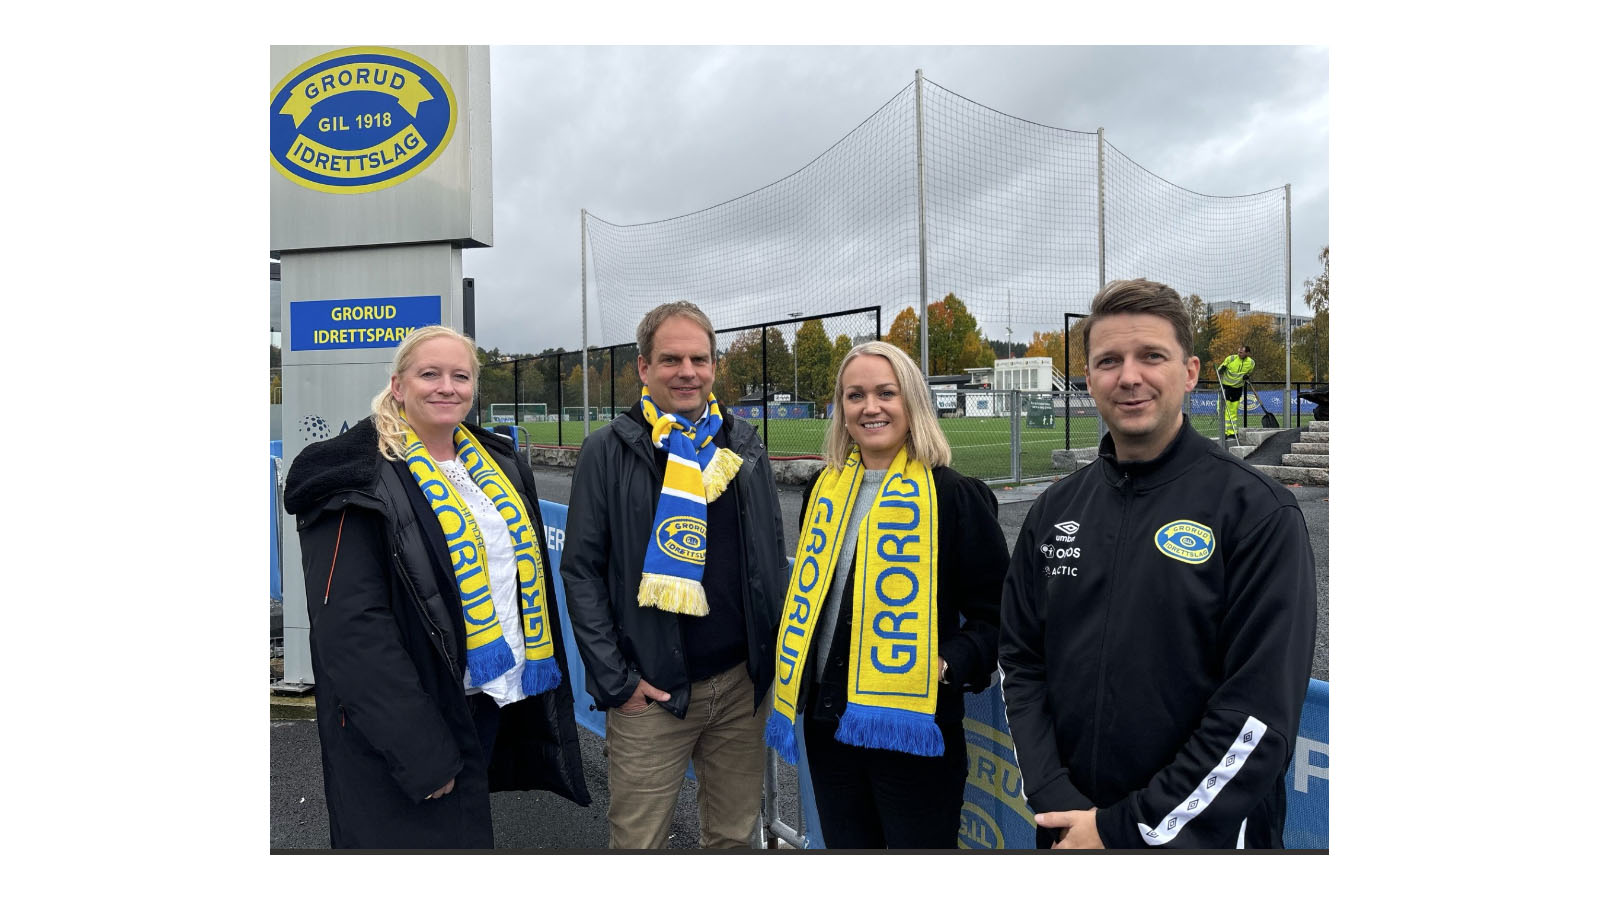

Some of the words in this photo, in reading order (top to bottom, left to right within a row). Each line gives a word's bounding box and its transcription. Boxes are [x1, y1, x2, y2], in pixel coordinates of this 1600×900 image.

[305, 68, 405, 99] GRORUD
[318, 116, 350, 132] GIL
[355, 112, 392, 129] 1918
[293, 133, 420, 172] IDRETTSLAG
[331, 305, 397, 321] GRORUD
[544, 525, 565, 551] ER
[675, 523, 706, 536] GRORU
[1056, 535, 1076, 543] umbr
[1173, 526, 1209, 539] GRORUD
[667, 541, 706, 559] IDRETTSL
[1166, 542, 1208, 558] IDRETTSLAG
[870, 472, 920, 674] GRORUD
[780, 496, 834, 686] GRORUD
[968, 757, 1022, 799] RU
